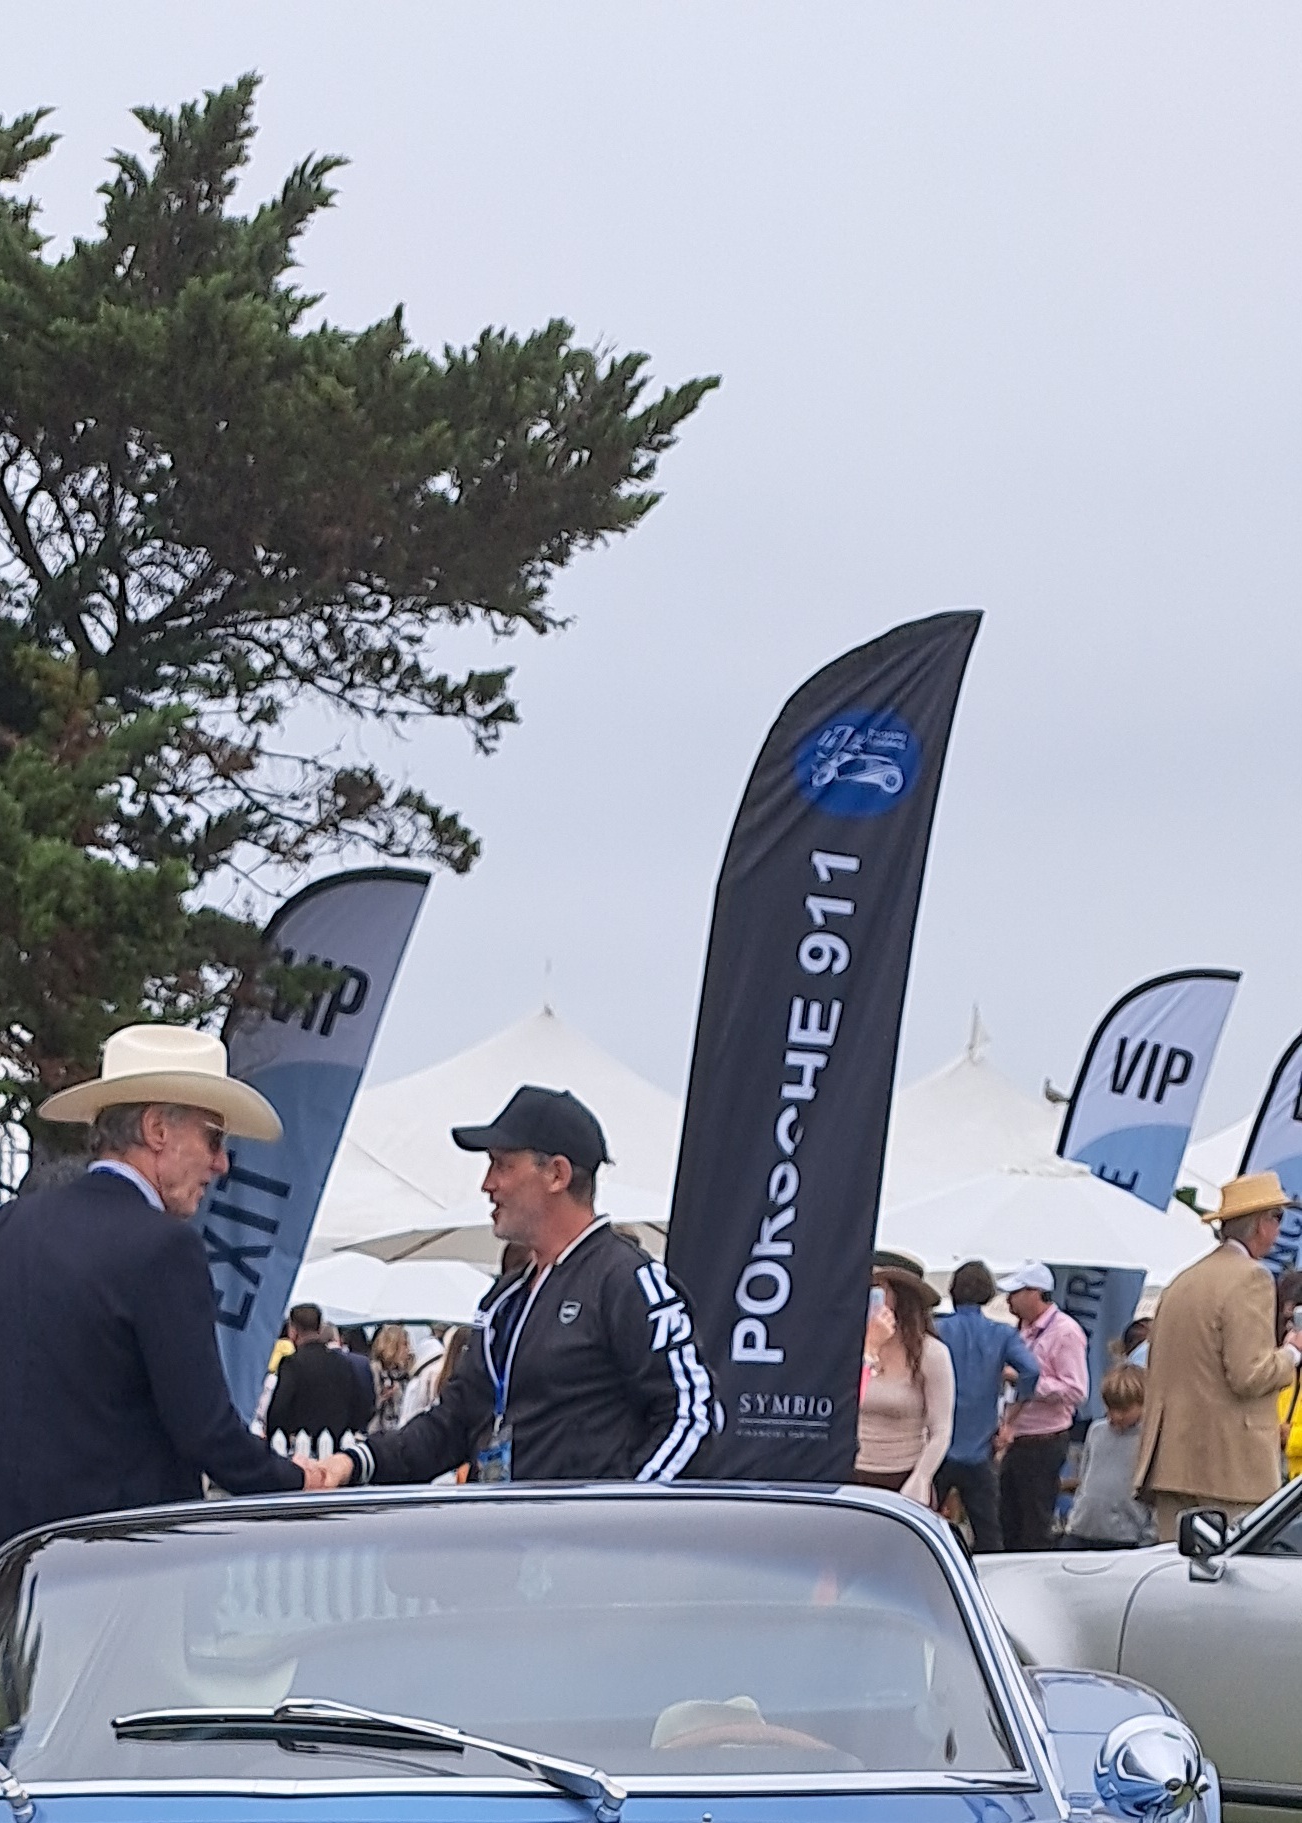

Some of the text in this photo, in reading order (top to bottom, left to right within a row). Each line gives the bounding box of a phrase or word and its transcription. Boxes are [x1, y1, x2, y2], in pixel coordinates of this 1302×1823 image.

[797, 848, 862, 976] 911
[1111, 1036, 1194, 1105] VIP
[738, 1391, 834, 1418] SYMBIO
